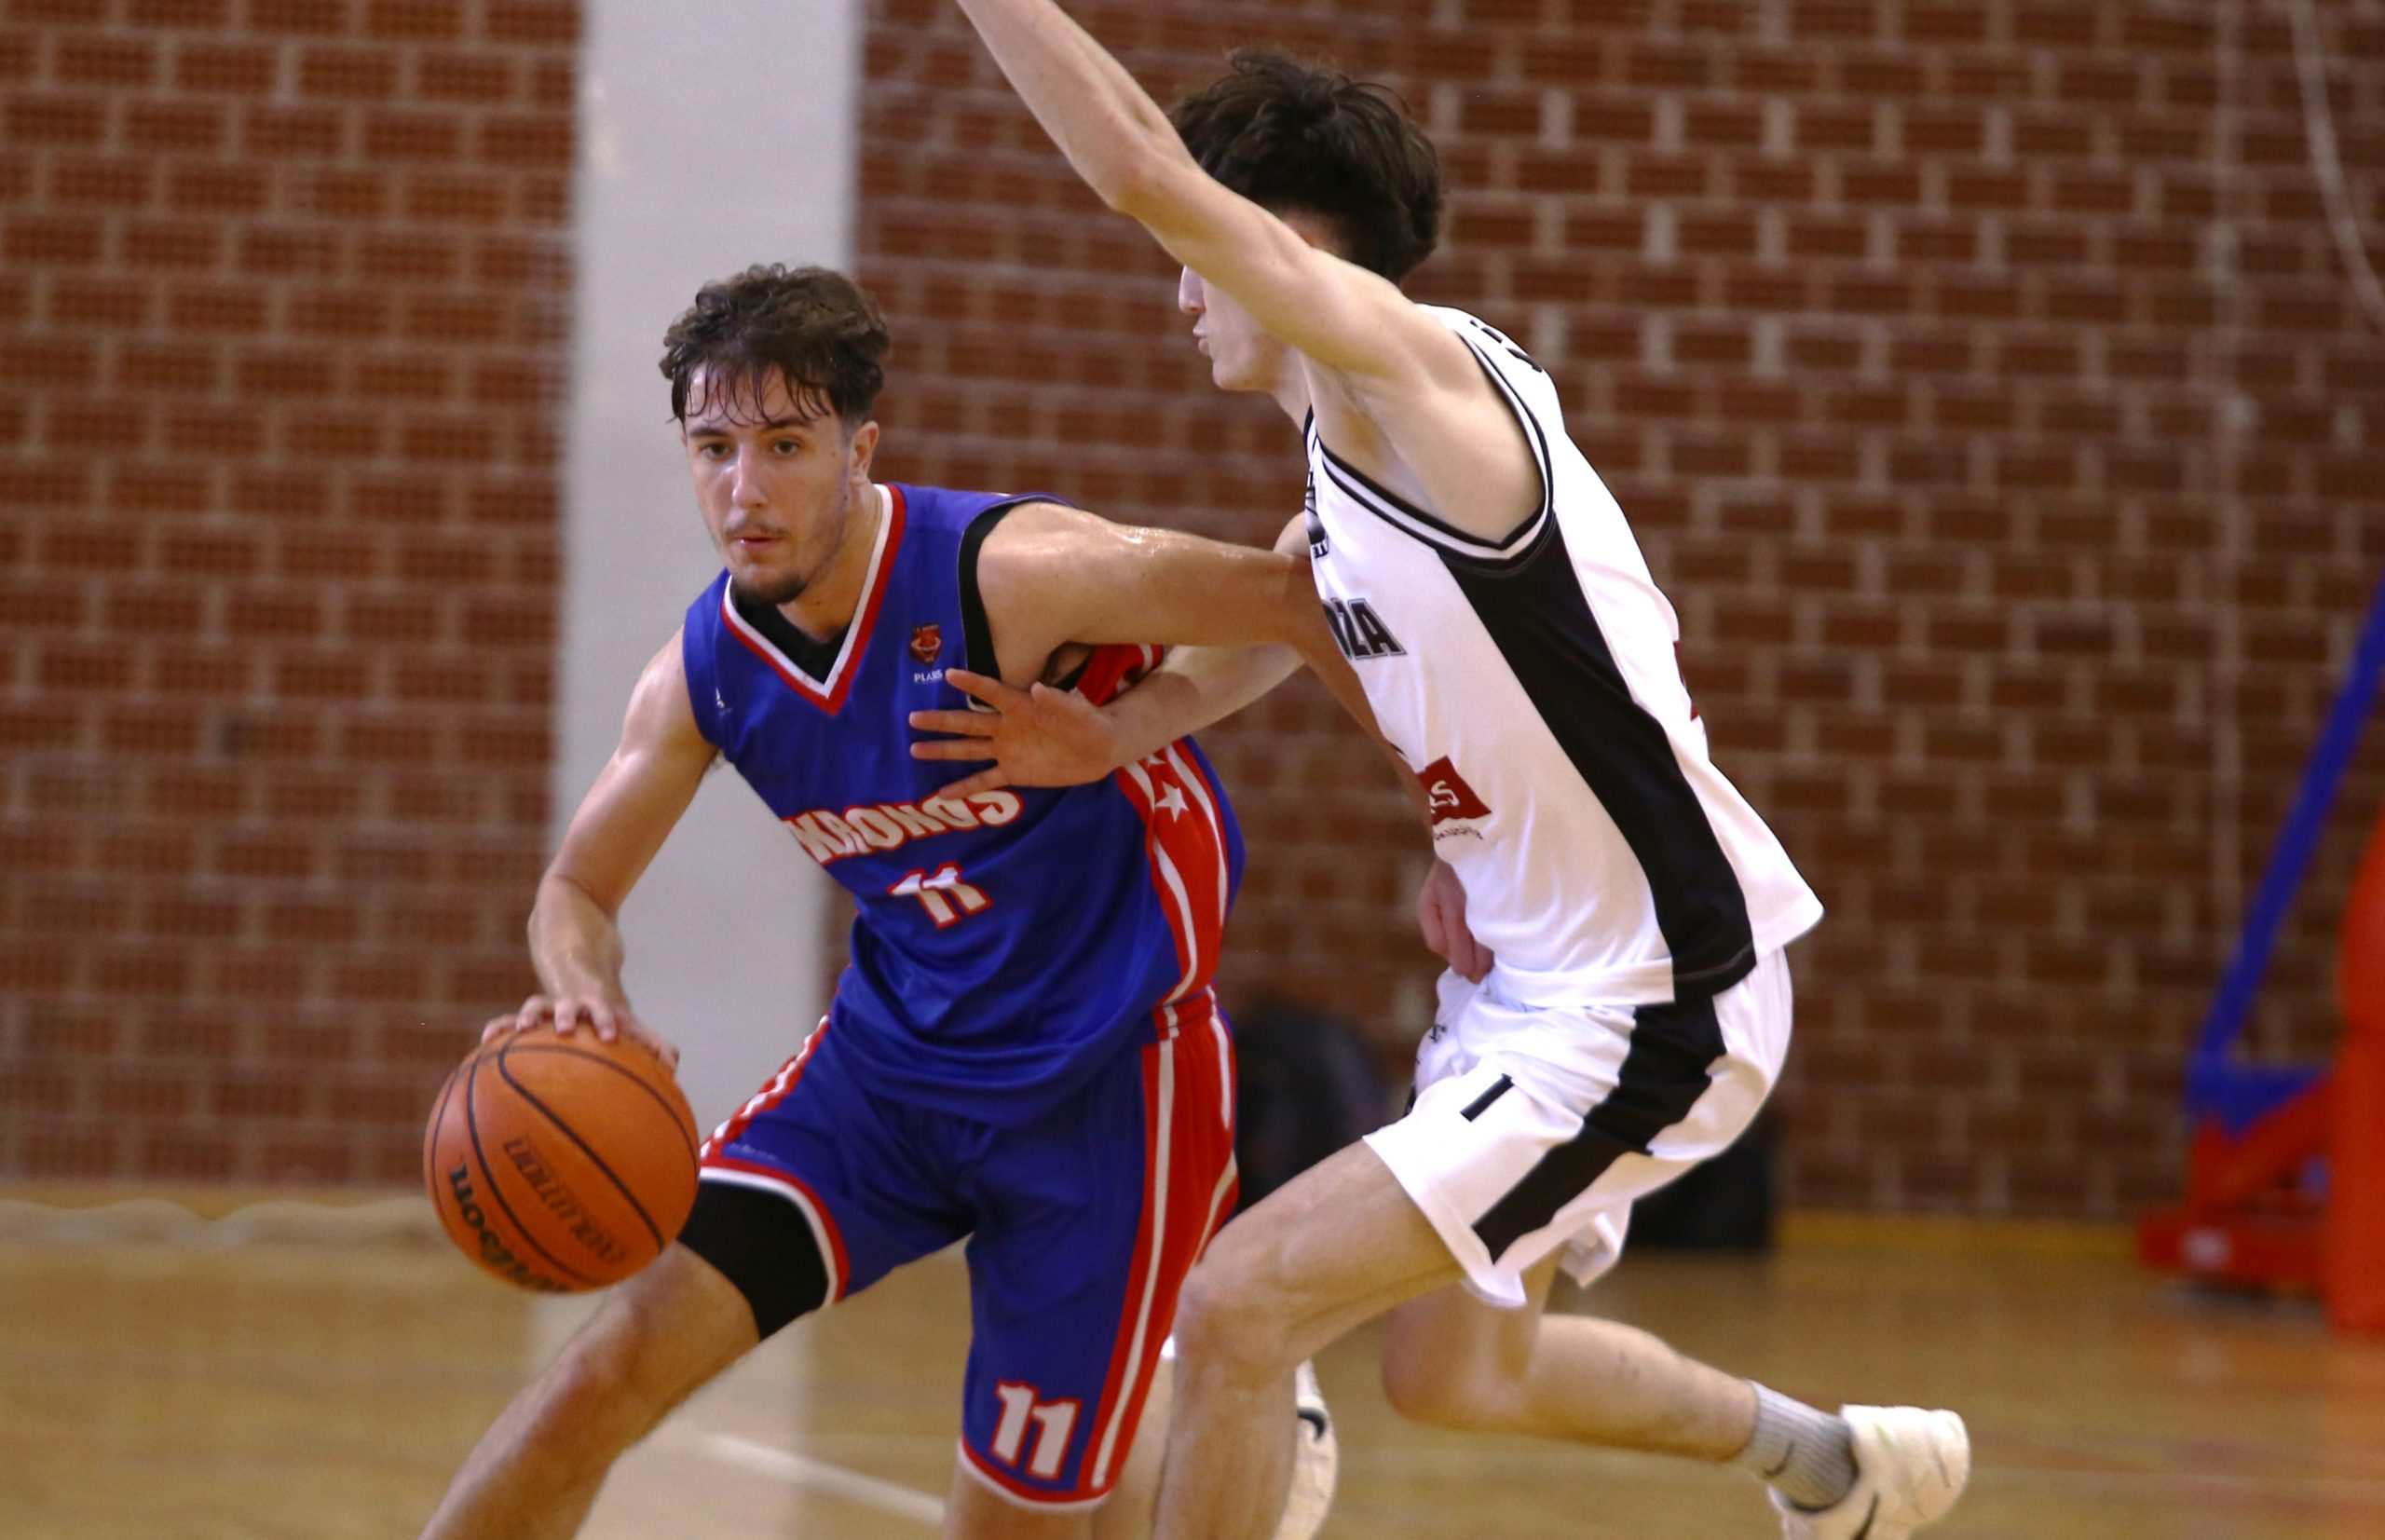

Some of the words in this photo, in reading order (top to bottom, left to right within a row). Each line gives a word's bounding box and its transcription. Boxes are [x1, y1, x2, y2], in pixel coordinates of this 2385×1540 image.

[887, 861, 993, 929] 11
[1459, 1072, 1515, 1123] 1
[989, 1378, 1083, 1481] 11
